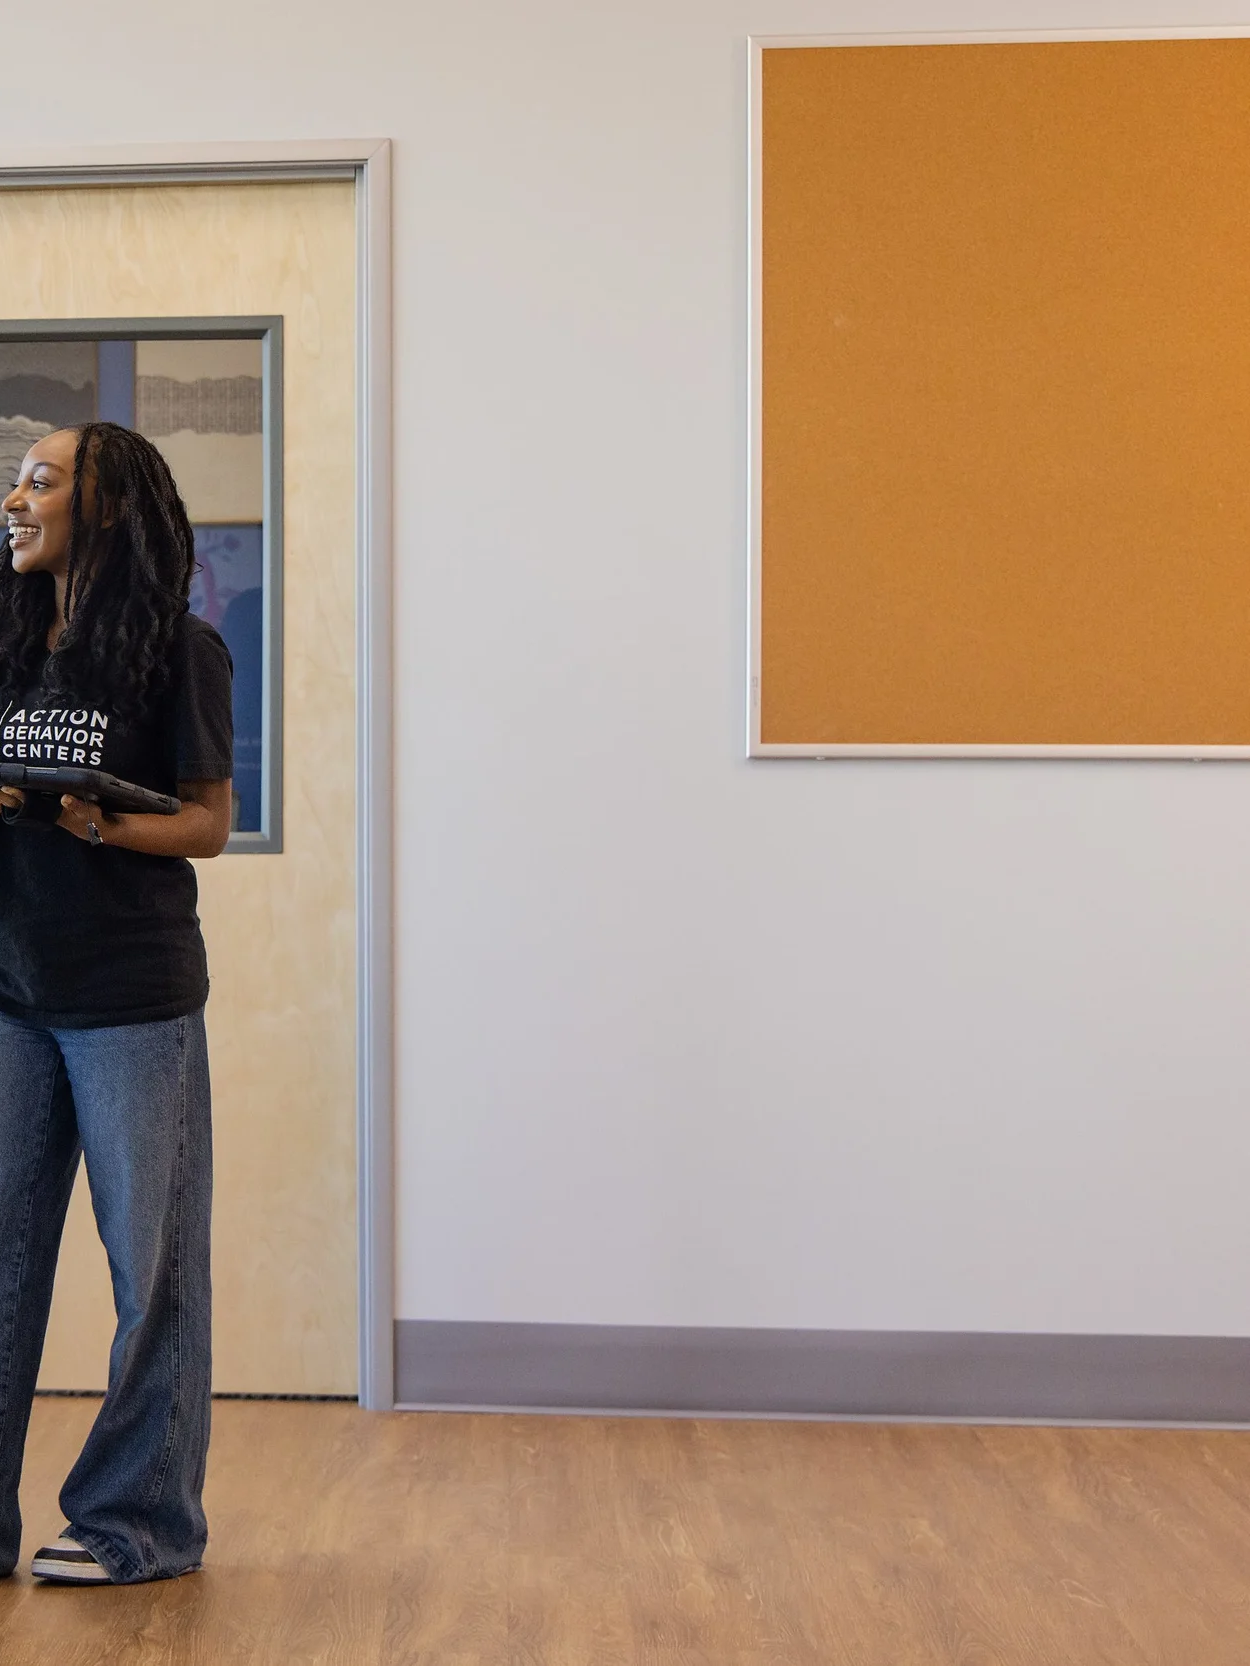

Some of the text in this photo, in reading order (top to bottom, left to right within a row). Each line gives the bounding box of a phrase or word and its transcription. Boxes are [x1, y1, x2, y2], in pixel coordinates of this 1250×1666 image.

[9, 709, 108, 729] ACTION
[3, 725, 104, 747] BEHAVIOR
[2, 743, 102, 765] CENTERS
